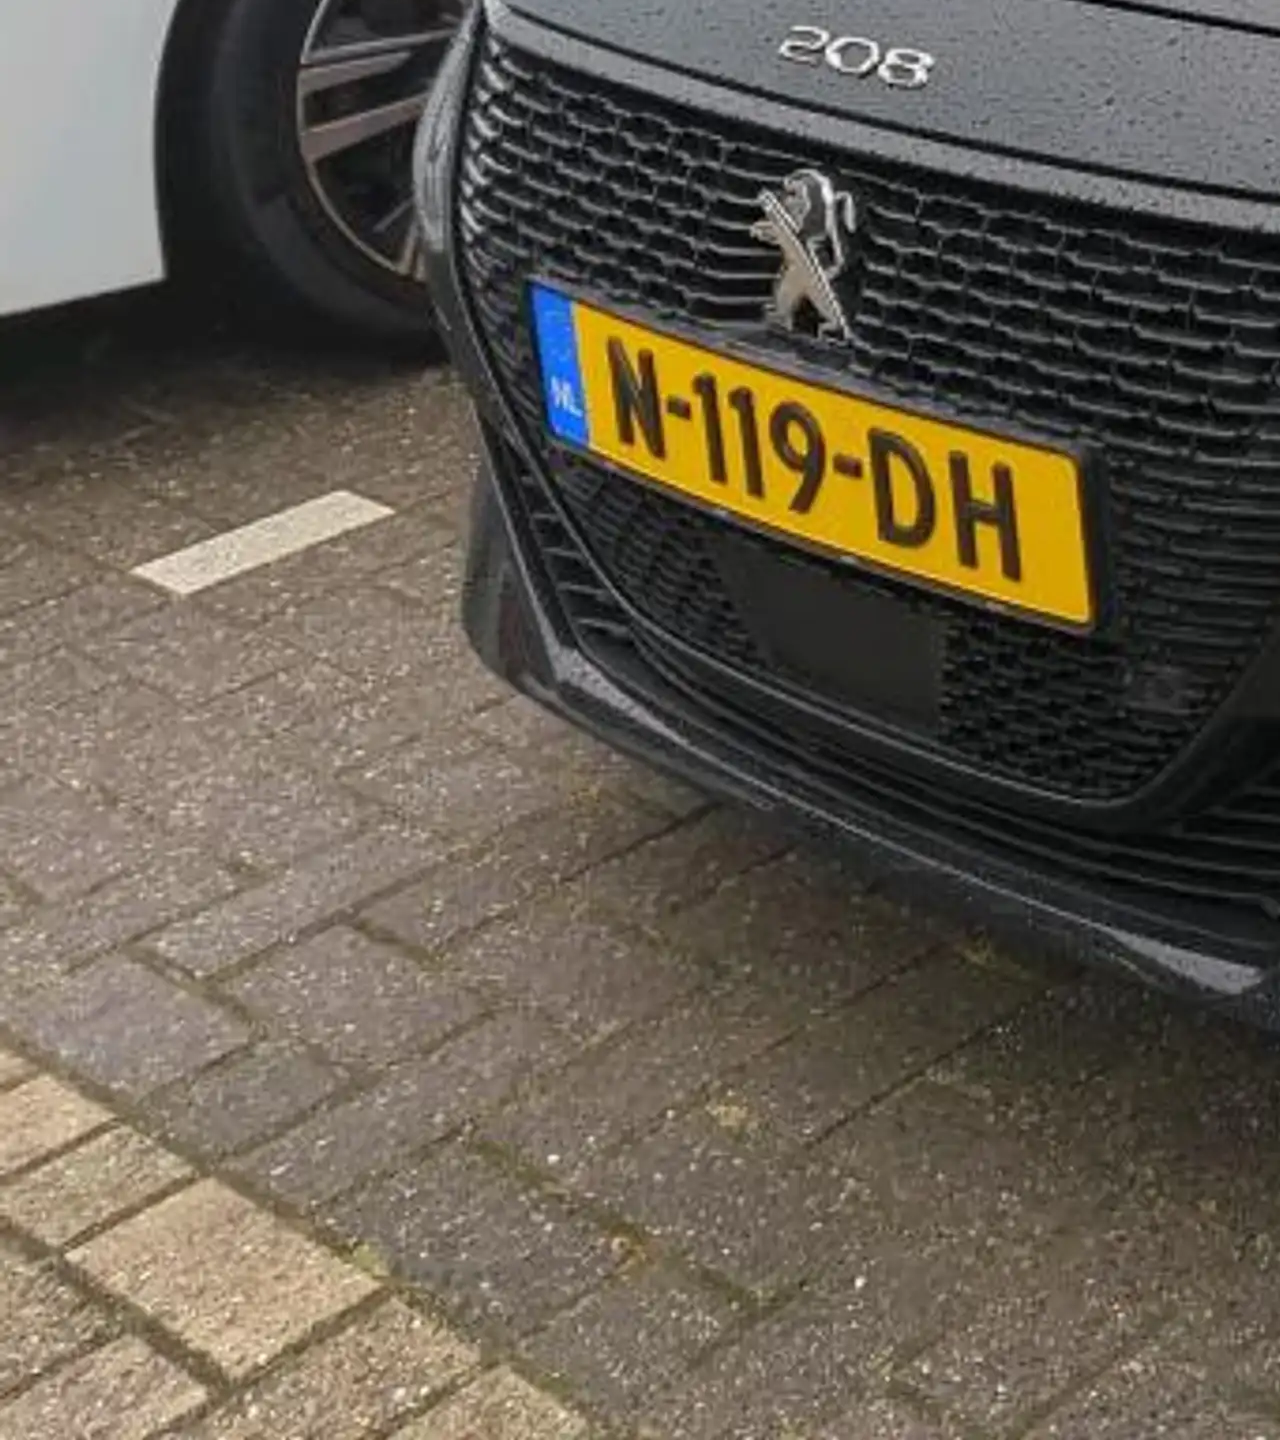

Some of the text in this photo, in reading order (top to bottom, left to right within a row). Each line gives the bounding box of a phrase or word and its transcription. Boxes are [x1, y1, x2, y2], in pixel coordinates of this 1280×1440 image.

[778, 25, 936, 88] 208
[551, 375, 583, 418] NL
[606, 335, 1022, 582] N-119-DH
